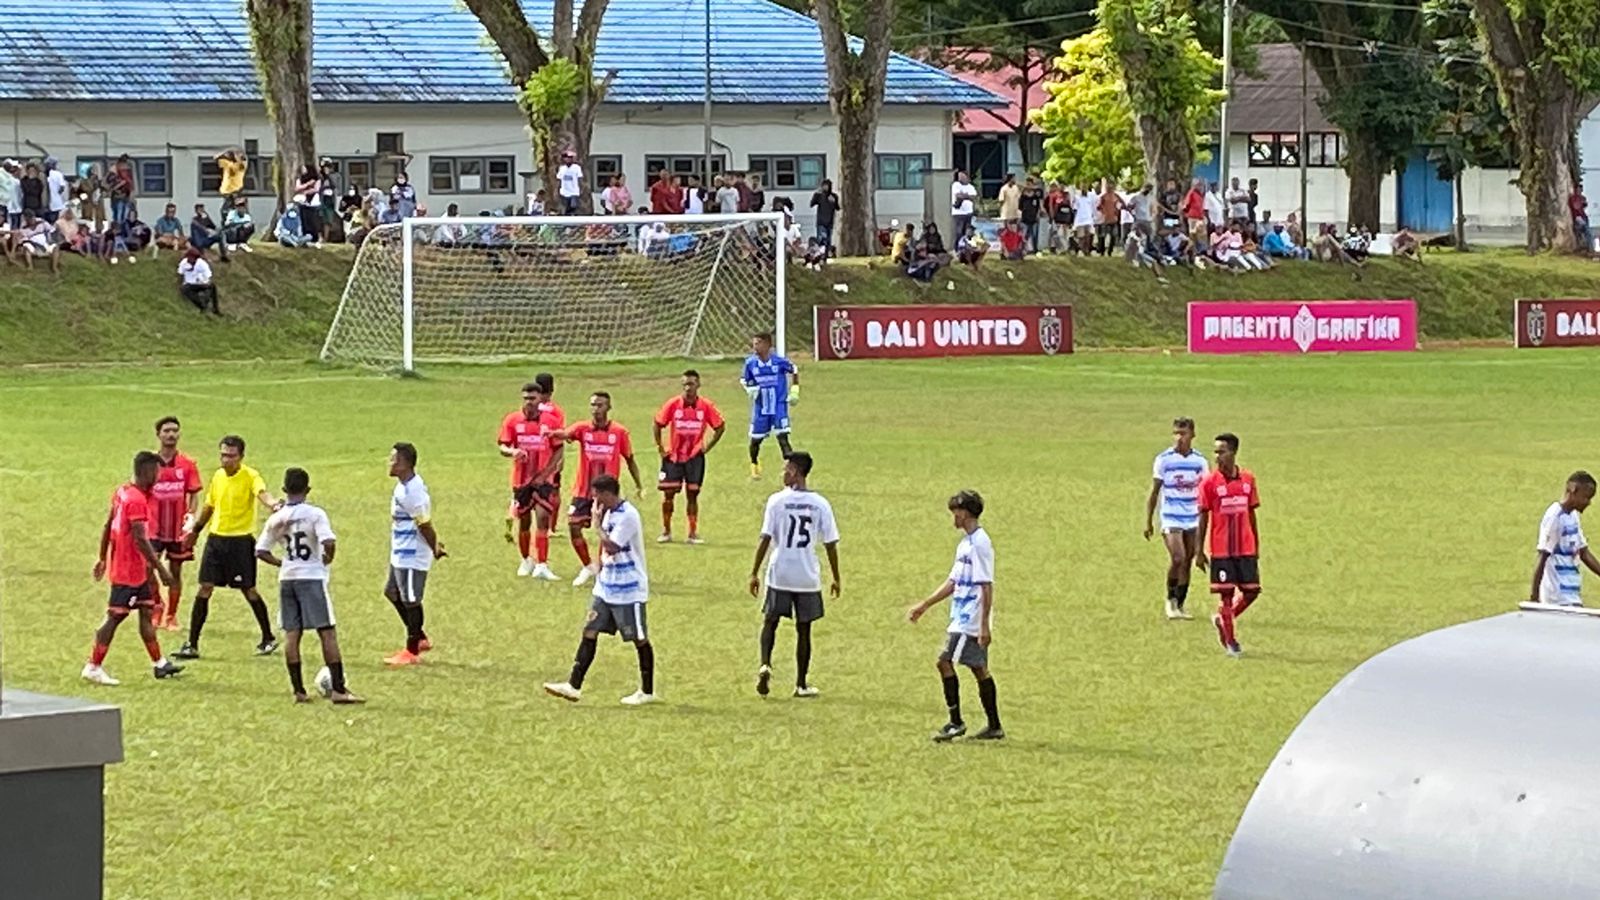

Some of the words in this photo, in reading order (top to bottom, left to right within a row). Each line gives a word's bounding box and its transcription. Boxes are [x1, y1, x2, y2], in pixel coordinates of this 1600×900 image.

[866, 320, 926, 347] BALI
[933, 319, 1027, 346] UNITED
[1317, 315, 1400, 341] GRAFIKA
[283, 531, 312, 561] 16
[786, 514, 812, 549] 15
